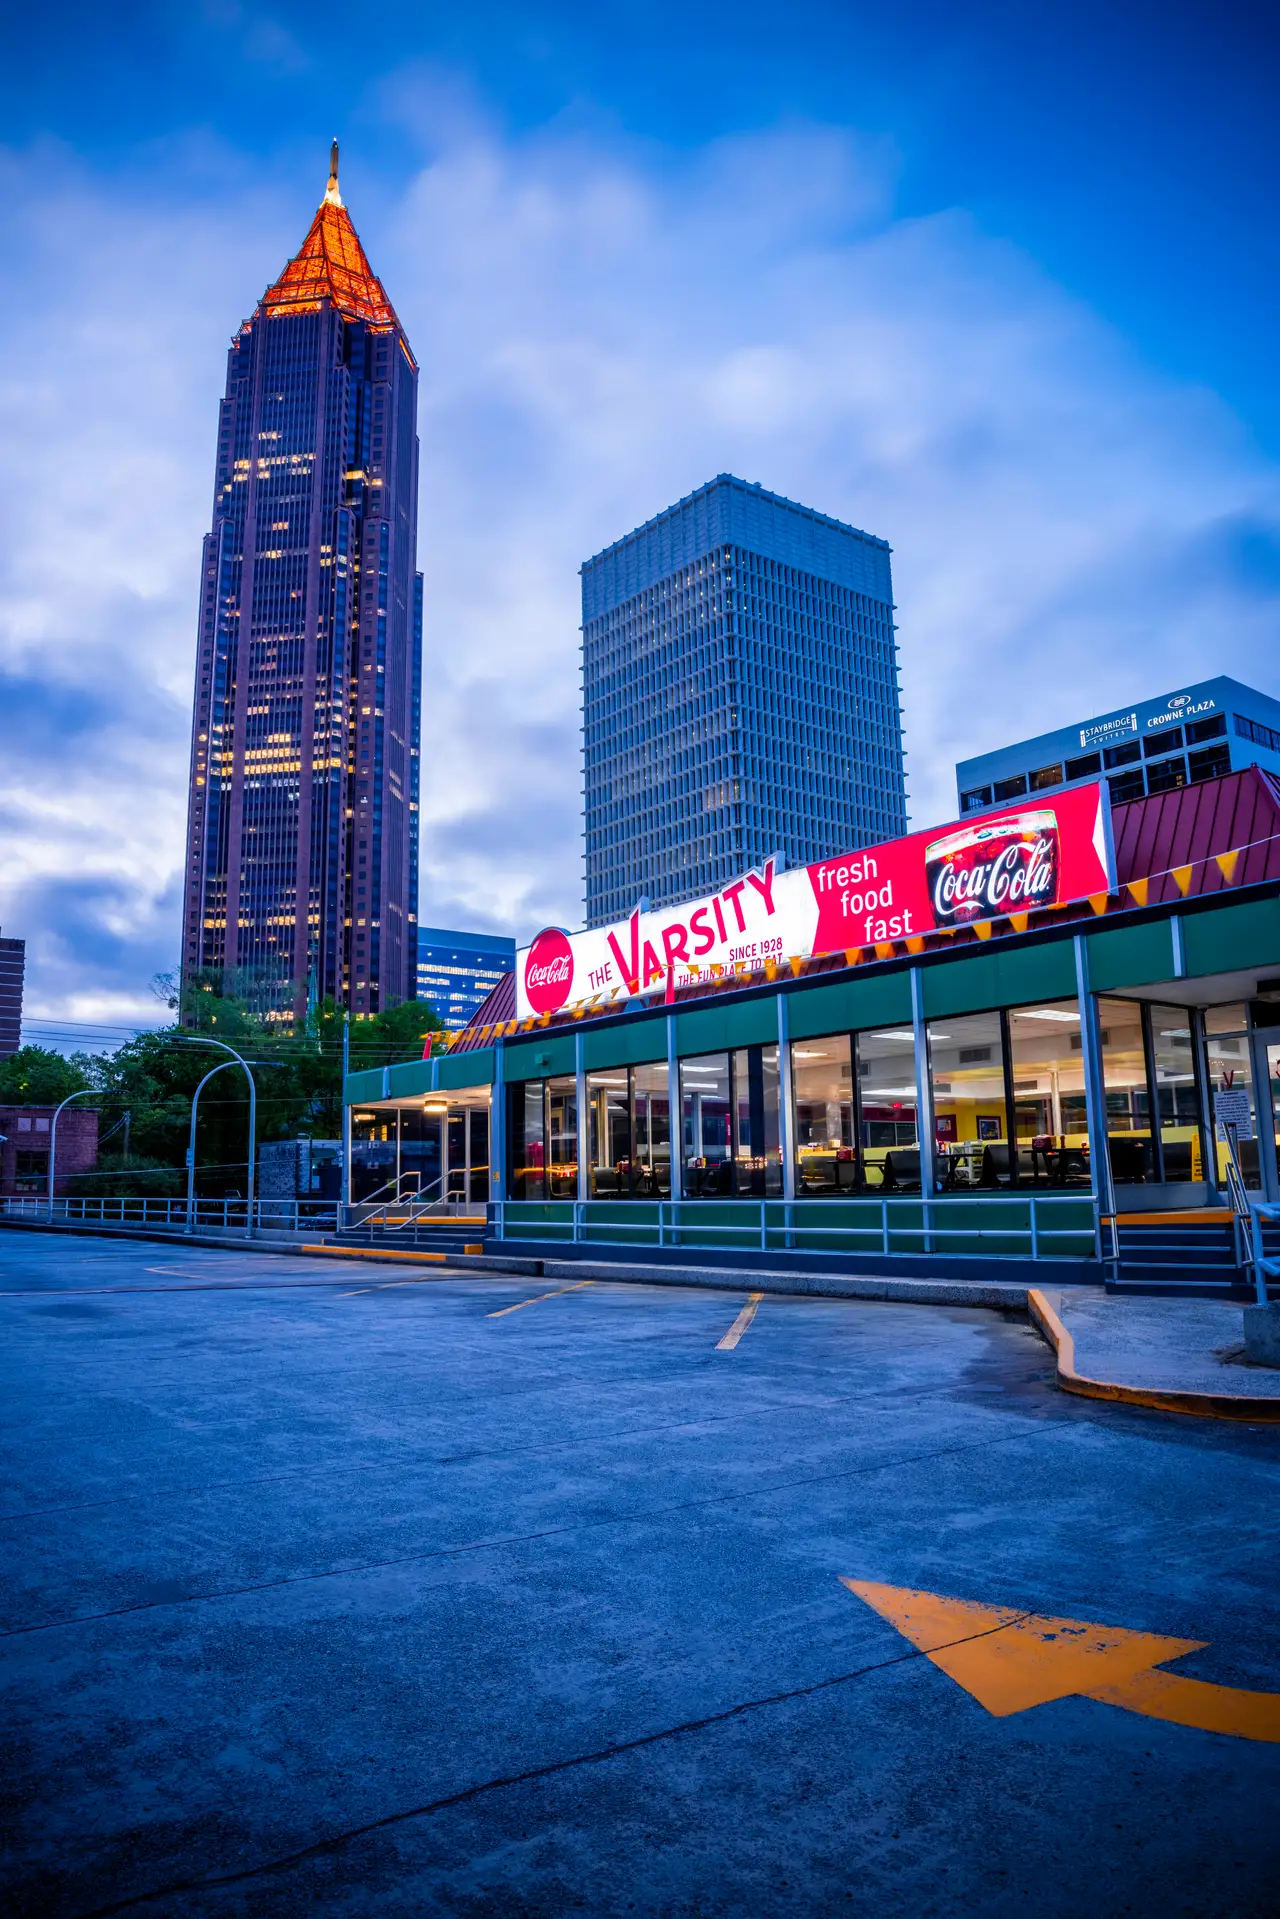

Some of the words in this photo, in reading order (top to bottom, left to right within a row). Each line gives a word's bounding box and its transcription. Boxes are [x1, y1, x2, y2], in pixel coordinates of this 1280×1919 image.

[1086, 716, 1131, 737] STAYBRIDGE
[1147, 709, 1184, 728] CROWNE
[1187, 700, 1215, 715] PLAZA
[1093, 731, 1125, 744] SUITES
[817, 855, 877, 892] fresh
[935, 838, 1053, 915] Coca-Cola
[840, 880, 893, 916] food
[588, 962, 612, 990] THE
[607, 860, 776, 1003] VARSITY
[864, 909, 913, 942] fast
[729, 943, 757, 961] SINCE
[760, 937, 783, 954] 1928
[527, 954, 571, 989] Coca-Cola
[678, 974, 694, 987] THE
[719, 963, 746, 978] PLAE
[751, 957, 762, 971] TO
